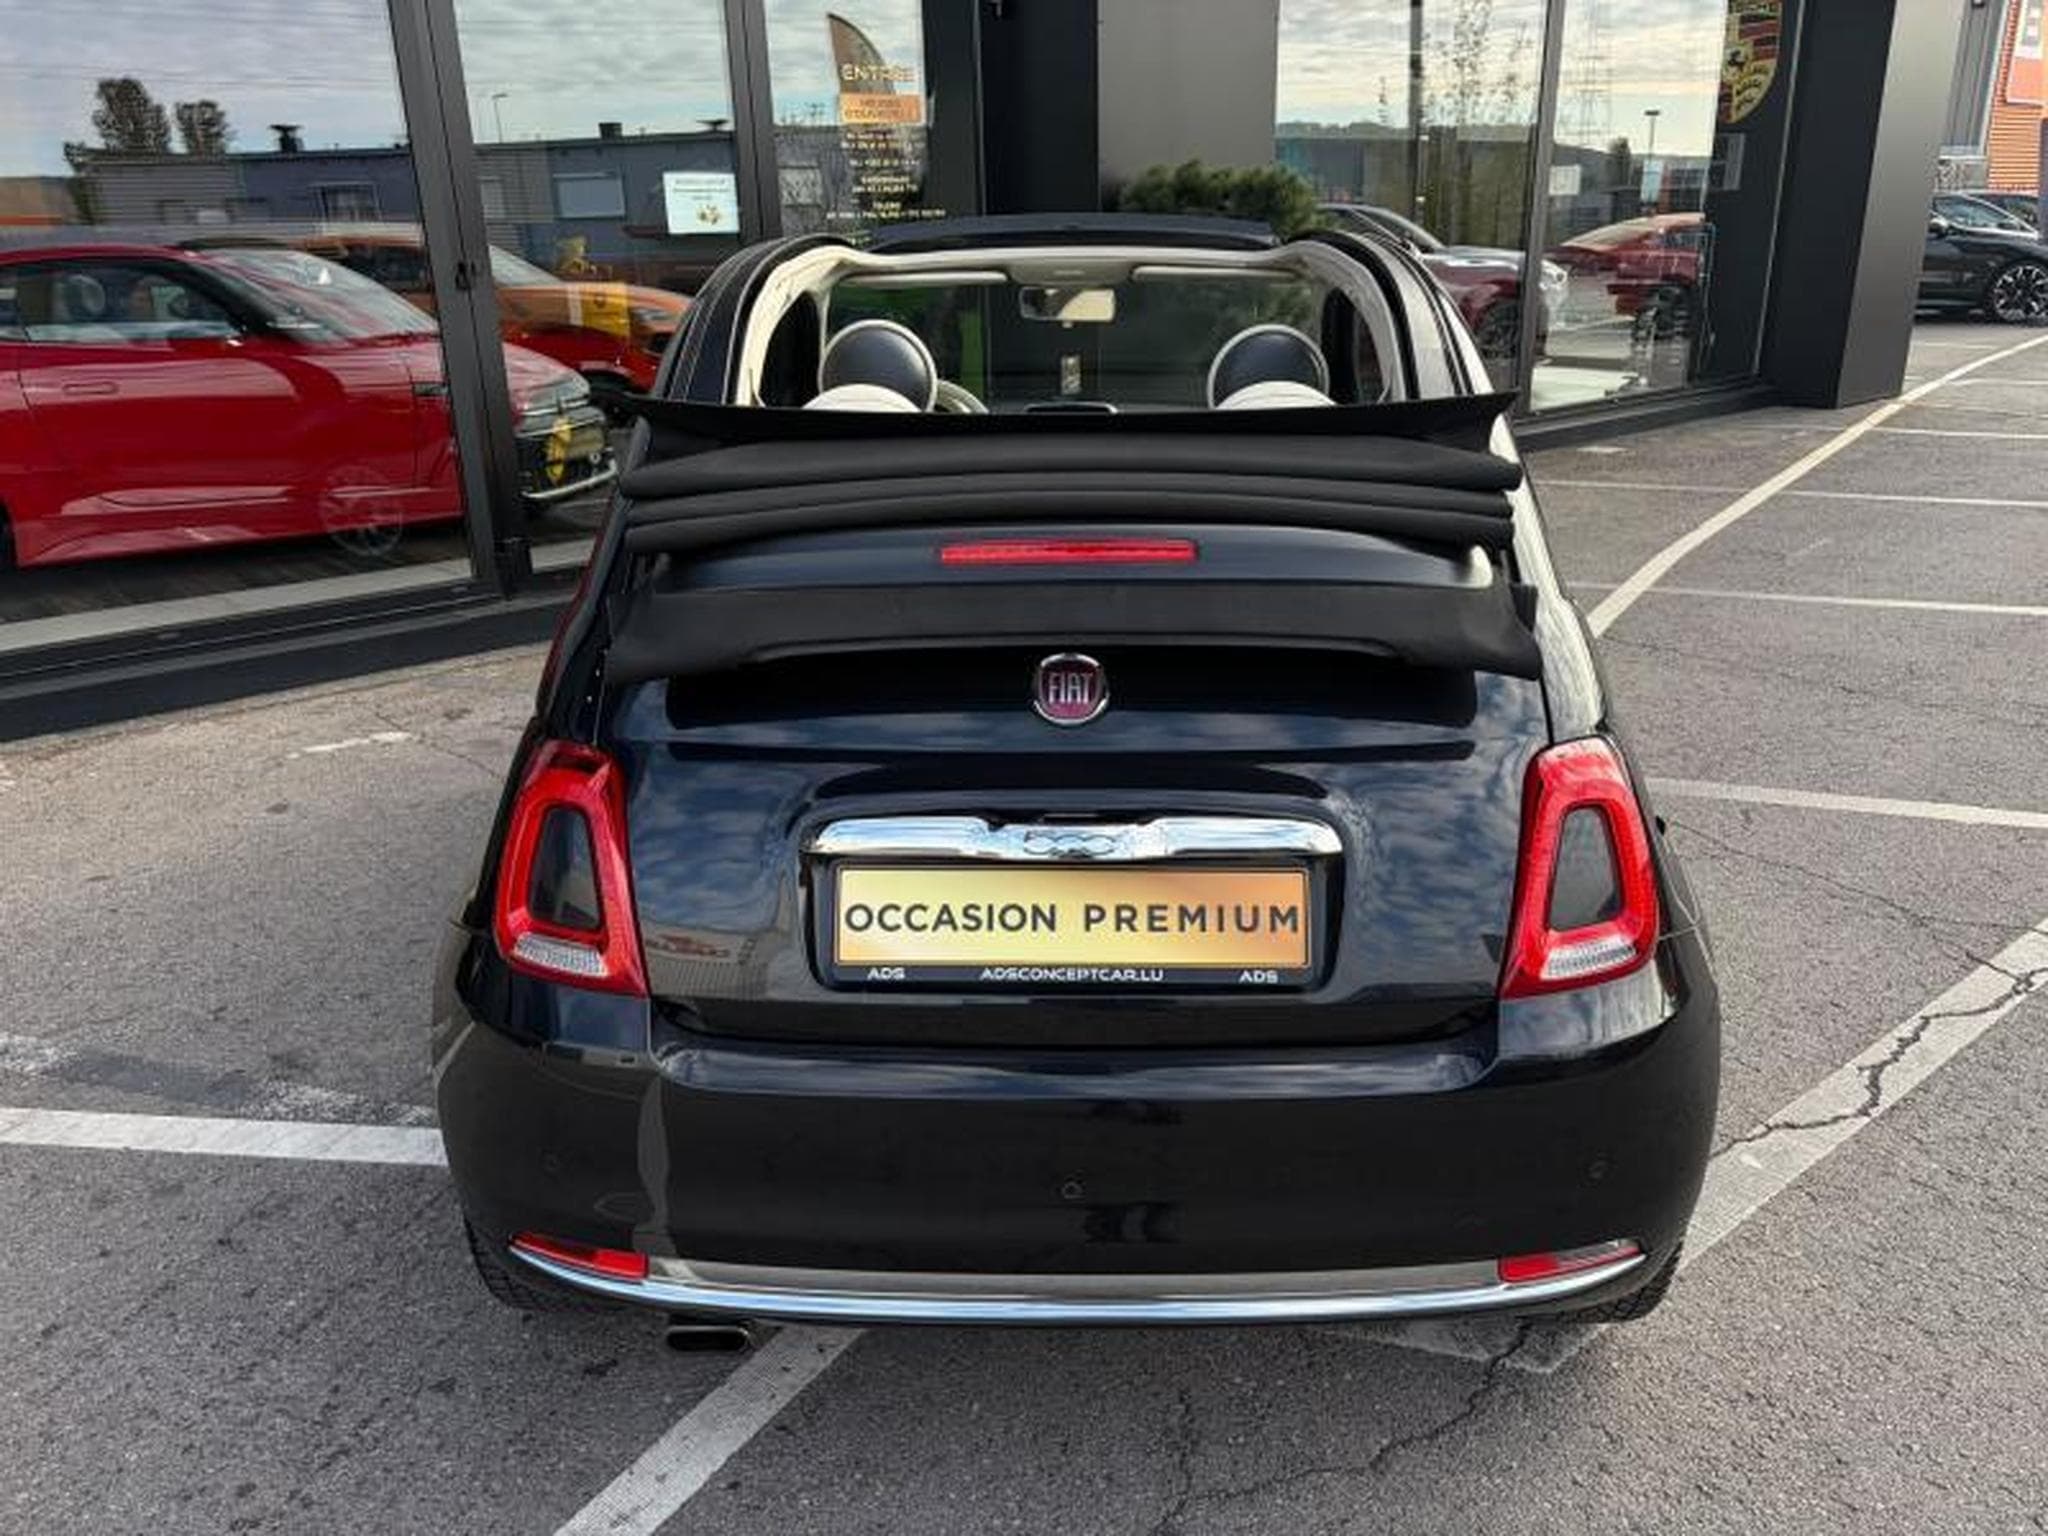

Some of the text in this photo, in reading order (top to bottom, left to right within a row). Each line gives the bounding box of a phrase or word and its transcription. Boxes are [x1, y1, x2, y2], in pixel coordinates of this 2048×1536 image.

[1049, 672, 1093, 704] FIAT
[845, 903, 1299, 933] OCCASION PREMIUM
[867, 967, 1279, 983] ADS ADSCONCEPTCAR.LU ADS
